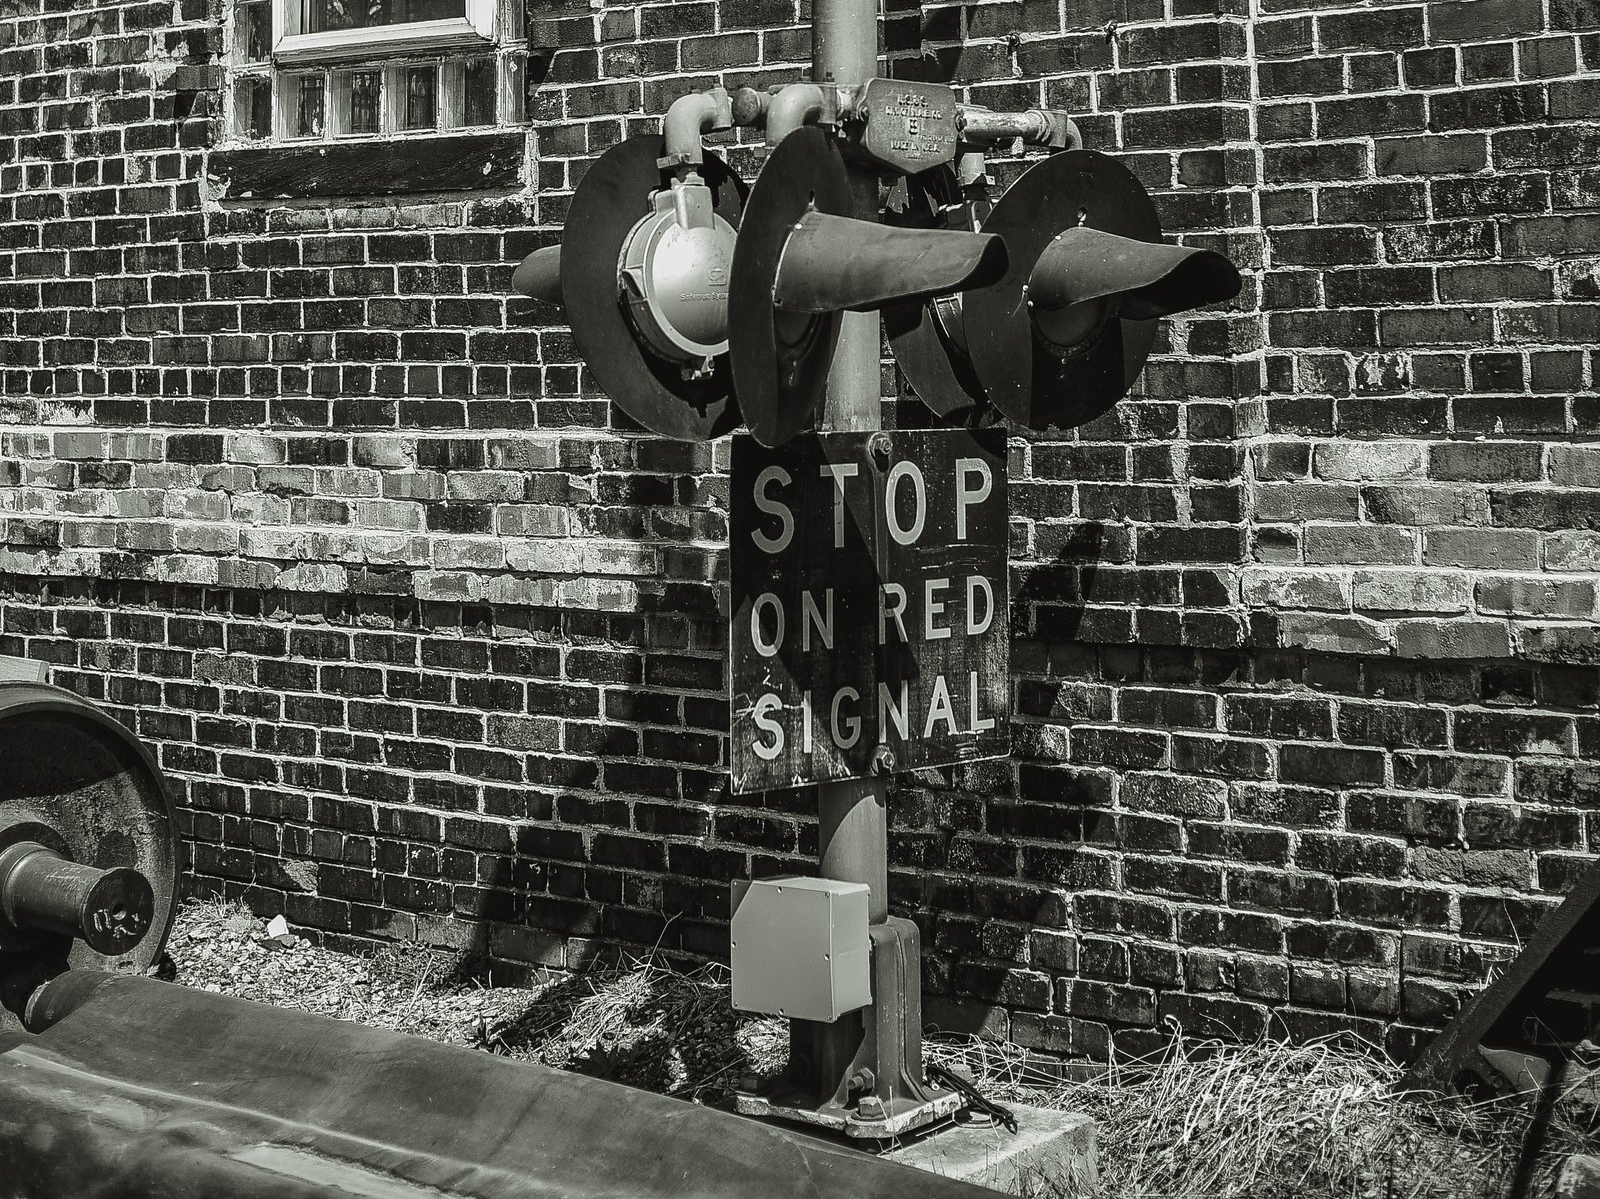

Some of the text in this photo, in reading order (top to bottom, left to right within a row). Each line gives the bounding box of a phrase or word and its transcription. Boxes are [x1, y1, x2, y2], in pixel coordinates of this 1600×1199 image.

[751, 457, 993, 554] STOP
[750, 575, 995, 657] ON RED
[751, 670, 996, 760] SIGNAL
